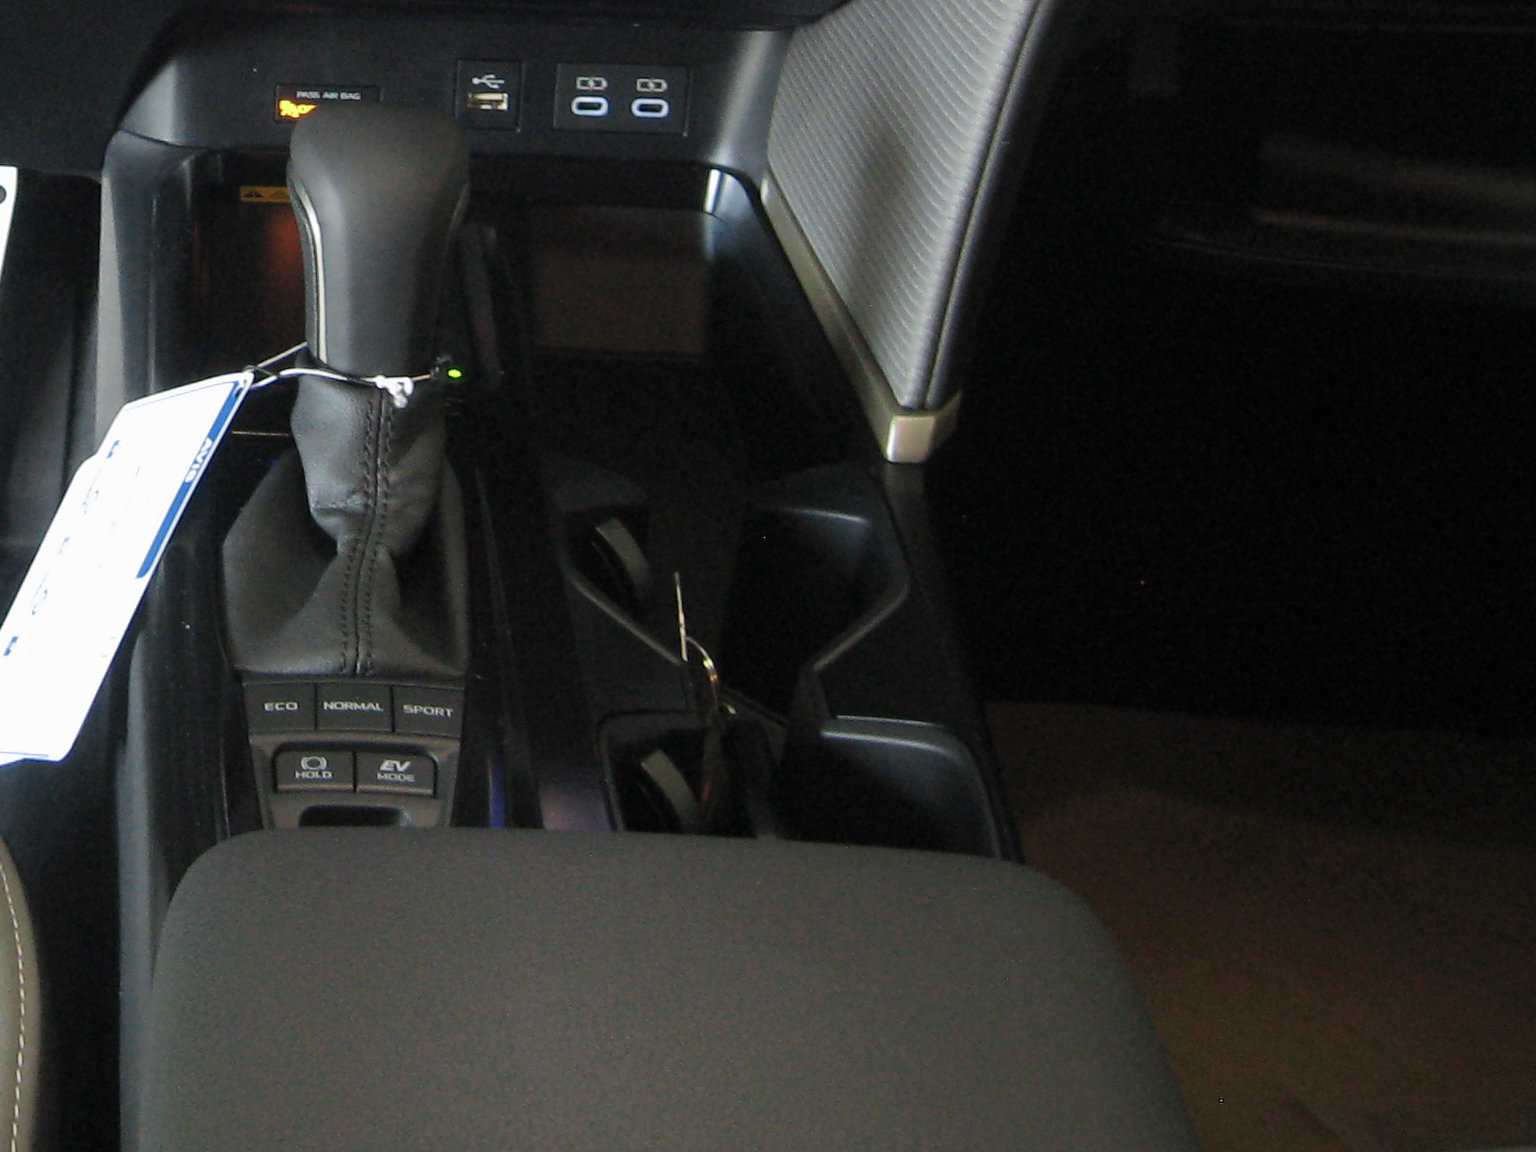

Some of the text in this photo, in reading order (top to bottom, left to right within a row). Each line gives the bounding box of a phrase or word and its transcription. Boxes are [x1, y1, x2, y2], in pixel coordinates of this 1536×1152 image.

[296, 90, 362, 101] PASS AIR BAG
[264, 701, 454, 717] ECO NORMAL SPORT
[379, 759, 412, 772] EV
[294, 770, 333, 780] HOLD
[376, 772, 416, 783] MODE
